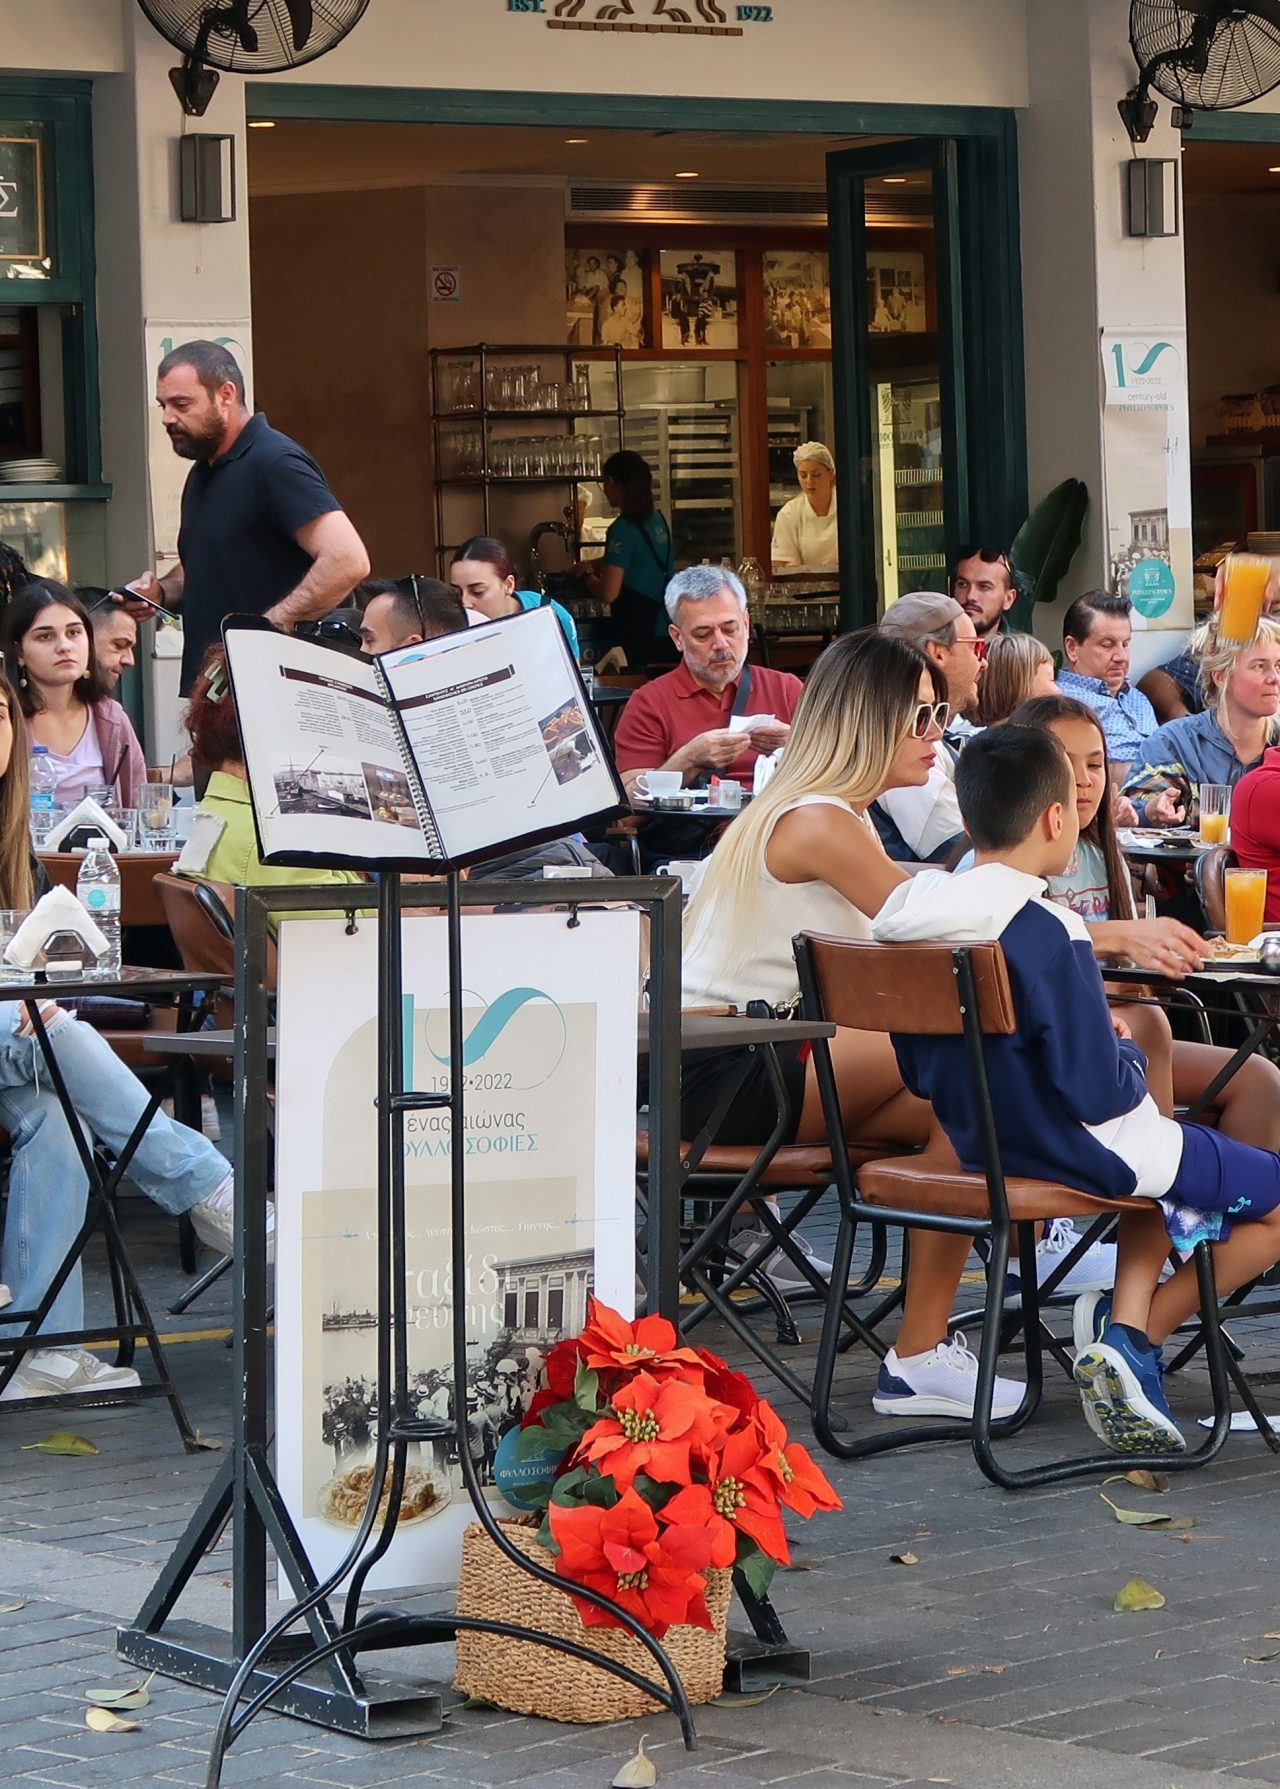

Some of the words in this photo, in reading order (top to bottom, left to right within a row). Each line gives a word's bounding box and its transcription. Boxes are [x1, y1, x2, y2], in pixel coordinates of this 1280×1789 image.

[736, 5, 774, 22] 1922
[431, 1072, 513, 1093] 192•2022
[406, 1113, 451, 1135] ένας
